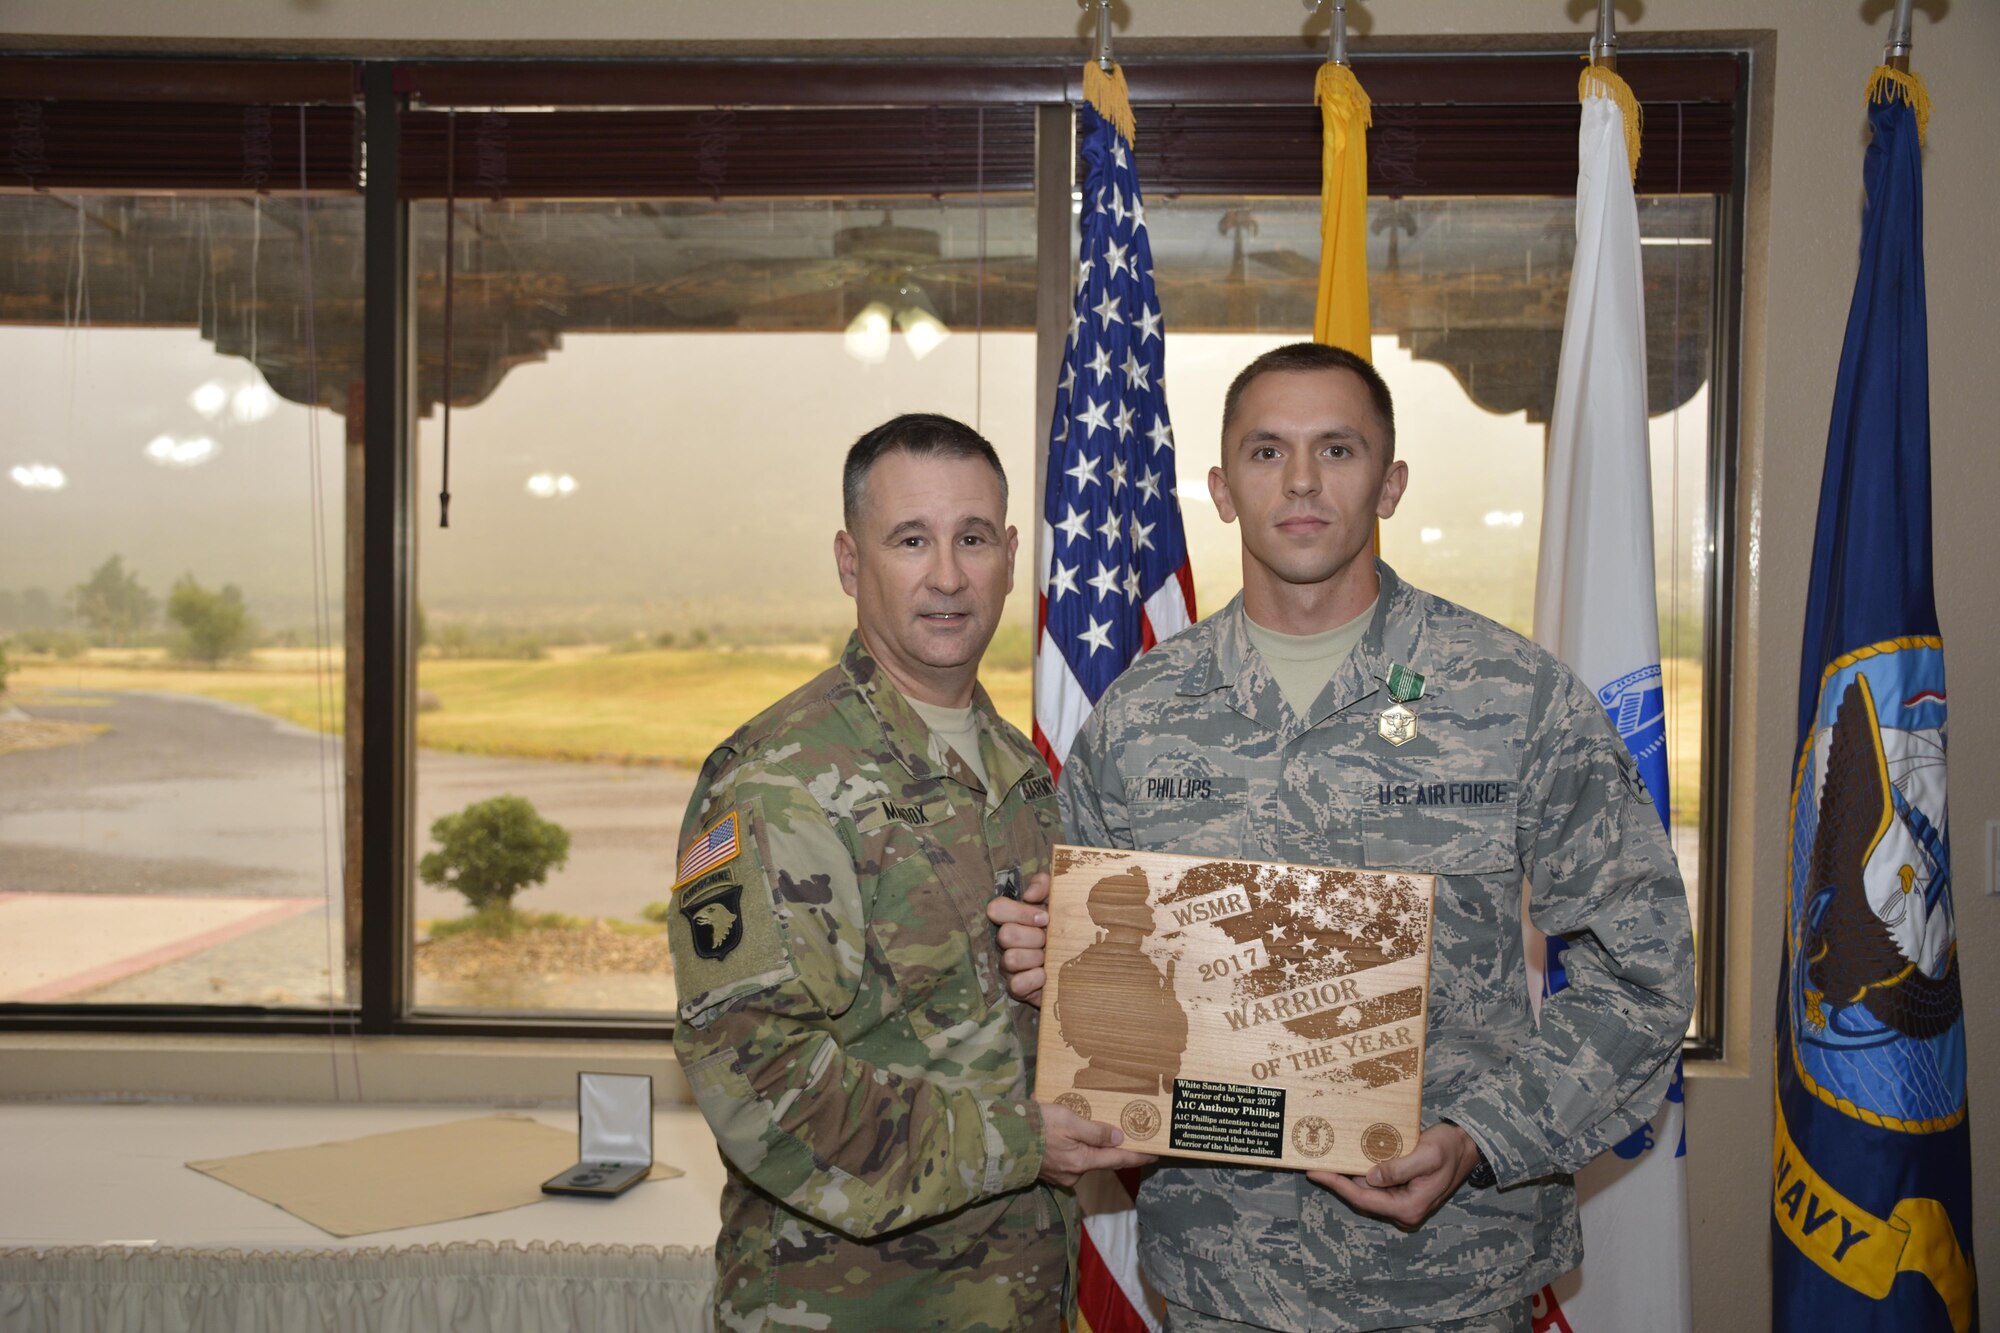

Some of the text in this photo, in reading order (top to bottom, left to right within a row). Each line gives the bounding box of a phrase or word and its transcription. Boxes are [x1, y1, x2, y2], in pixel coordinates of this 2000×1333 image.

[1147, 778, 1211, 800] PHILLIPS
[1377, 782, 1508, 806] U.S. AIR FORCE
[1172, 893, 1247, 927] WSMR
[1198, 948, 1260, 982] 2017
[1223, 978, 1363, 1032] WARRIOR
[1251, 1026, 1415, 1081] OF THE YEAR
[1178, 1080, 1282, 1097] White Sands Missile Range
[1182, 1090, 1276, 1106] Warrior of the Year 2017
[1176, 1100, 1280, 1119] A1C Anthony Phillips
[1174, 1123, 1278, 1138] professionalism and dedication
[1191, 1115, 1217, 1124] Phillips
[1218, 1118, 1250, 1127] attention
[1251, 1120, 1258, 1128] to
[1259, 1121, 1280, 1129] detail
[1175, 1139, 1276, 1156] Warrior of the highest caliber.
[1182, 1131, 1229, 1142] demonstrated
[1230, 1136, 1245, 1144] that
[1246, 1137, 1255, 1145] he
[1777, 1145, 1871, 1263] NAVY
